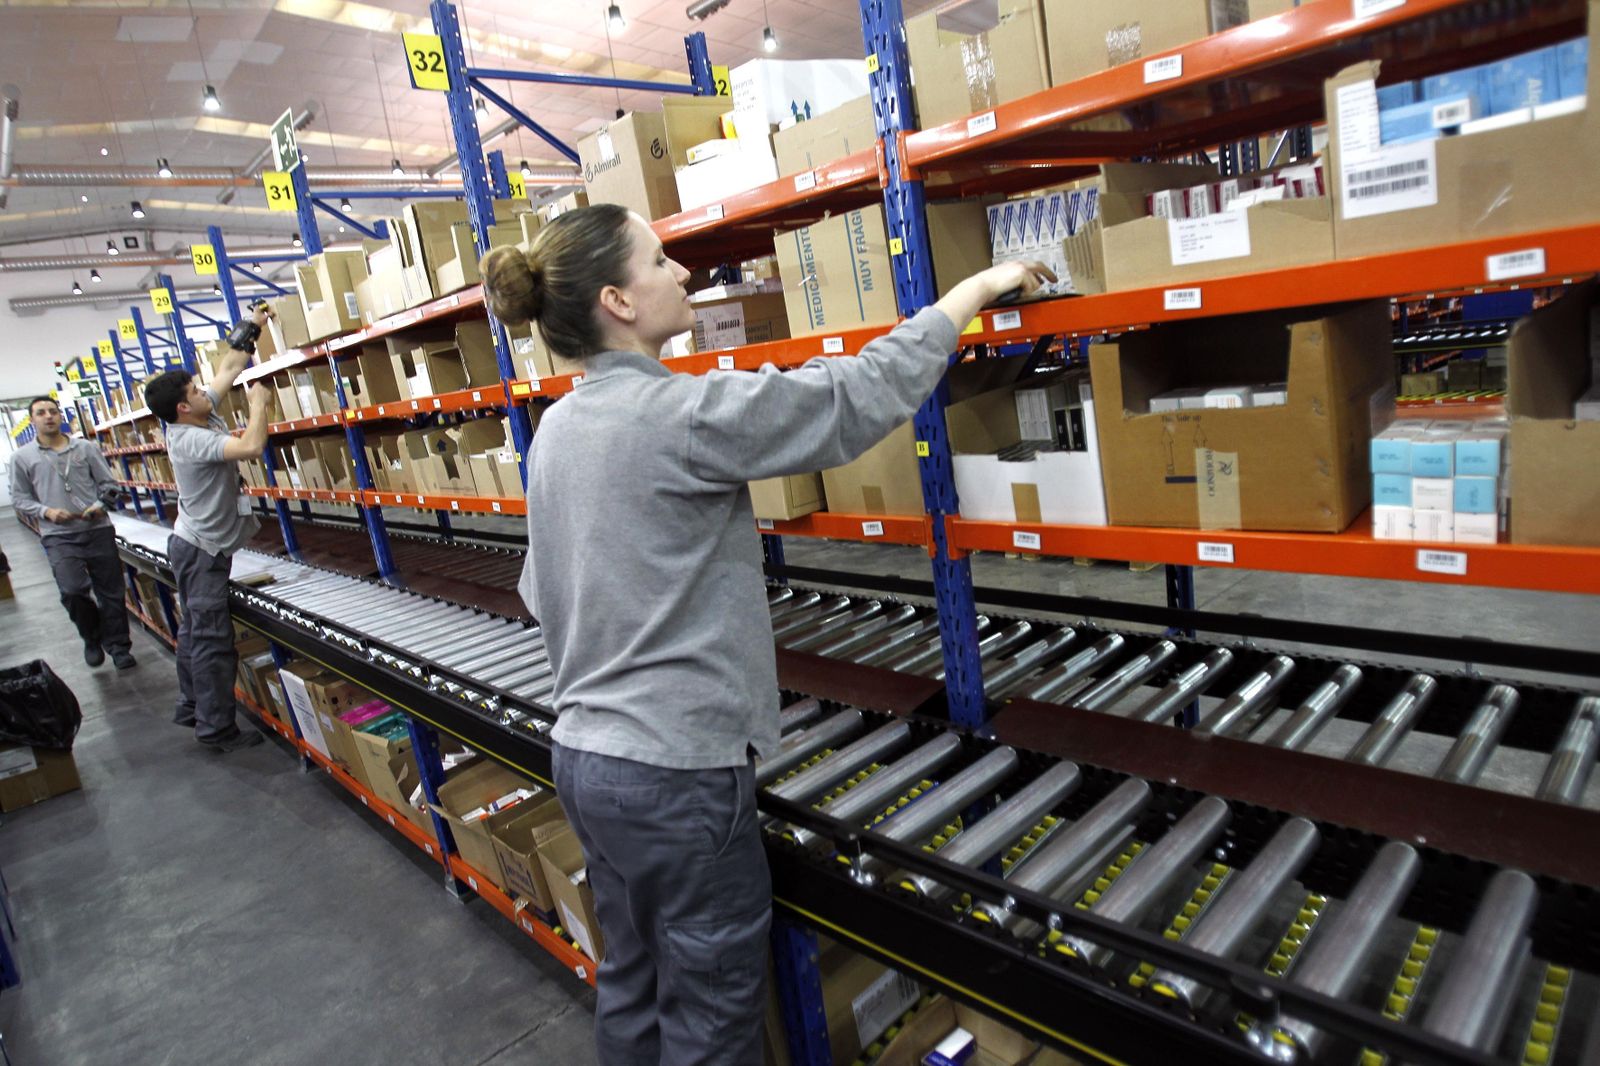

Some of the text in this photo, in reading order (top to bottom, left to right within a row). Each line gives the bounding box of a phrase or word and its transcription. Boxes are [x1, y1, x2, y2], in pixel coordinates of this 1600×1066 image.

[413, 49, 444, 73] 32
[593, 152, 621, 178] Almirall
[269, 185, 291, 201] 31
[194, 252, 213, 266] 30
[859, 259, 874, 292] MUY
[155, 296, 170, 307] 29
[121, 324, 135, 334] 28
[99, 344, 112, 354] 27
